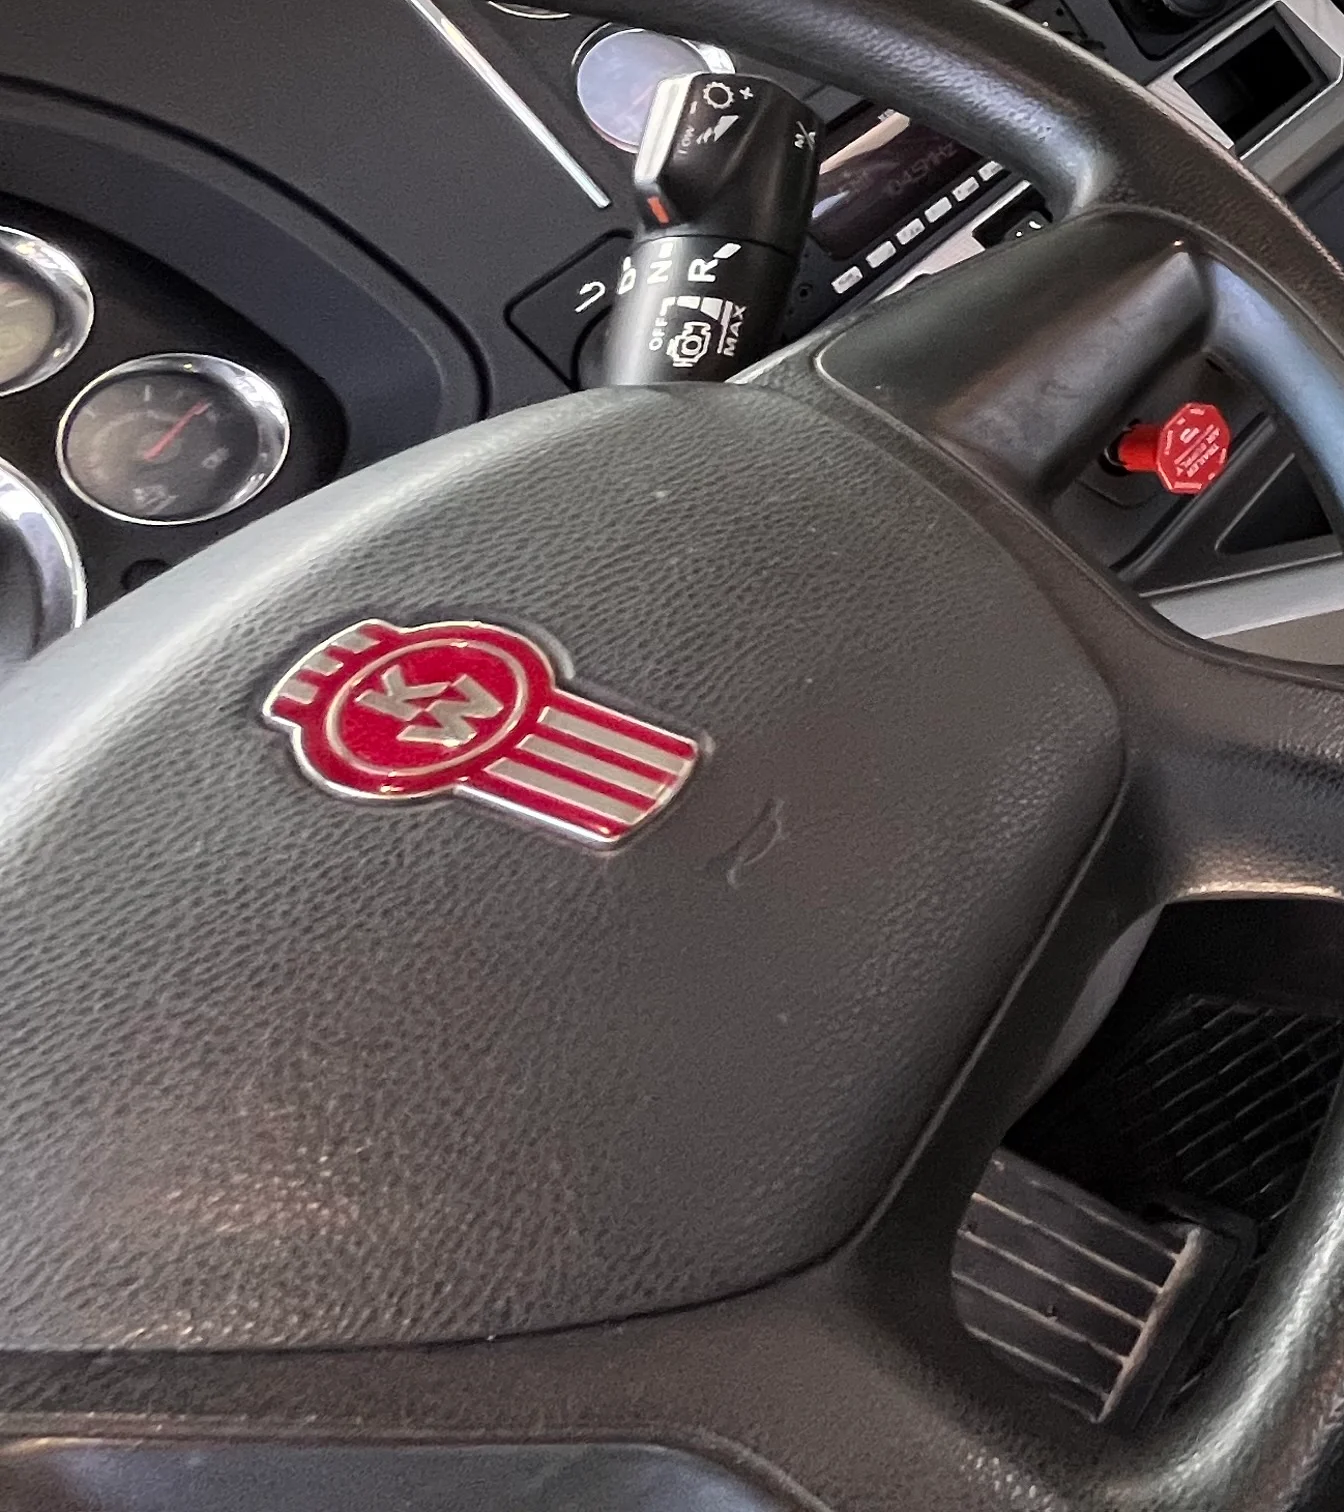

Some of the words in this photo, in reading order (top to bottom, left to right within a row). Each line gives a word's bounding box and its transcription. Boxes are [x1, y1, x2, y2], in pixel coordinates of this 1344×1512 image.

[647, 260, 672, 284] N
[688, 258, 718, 282] R
[649, 317, 668, 351] OFF
[723, 304, 747, 356] MAX
[355, 665, 504, 745] KW
